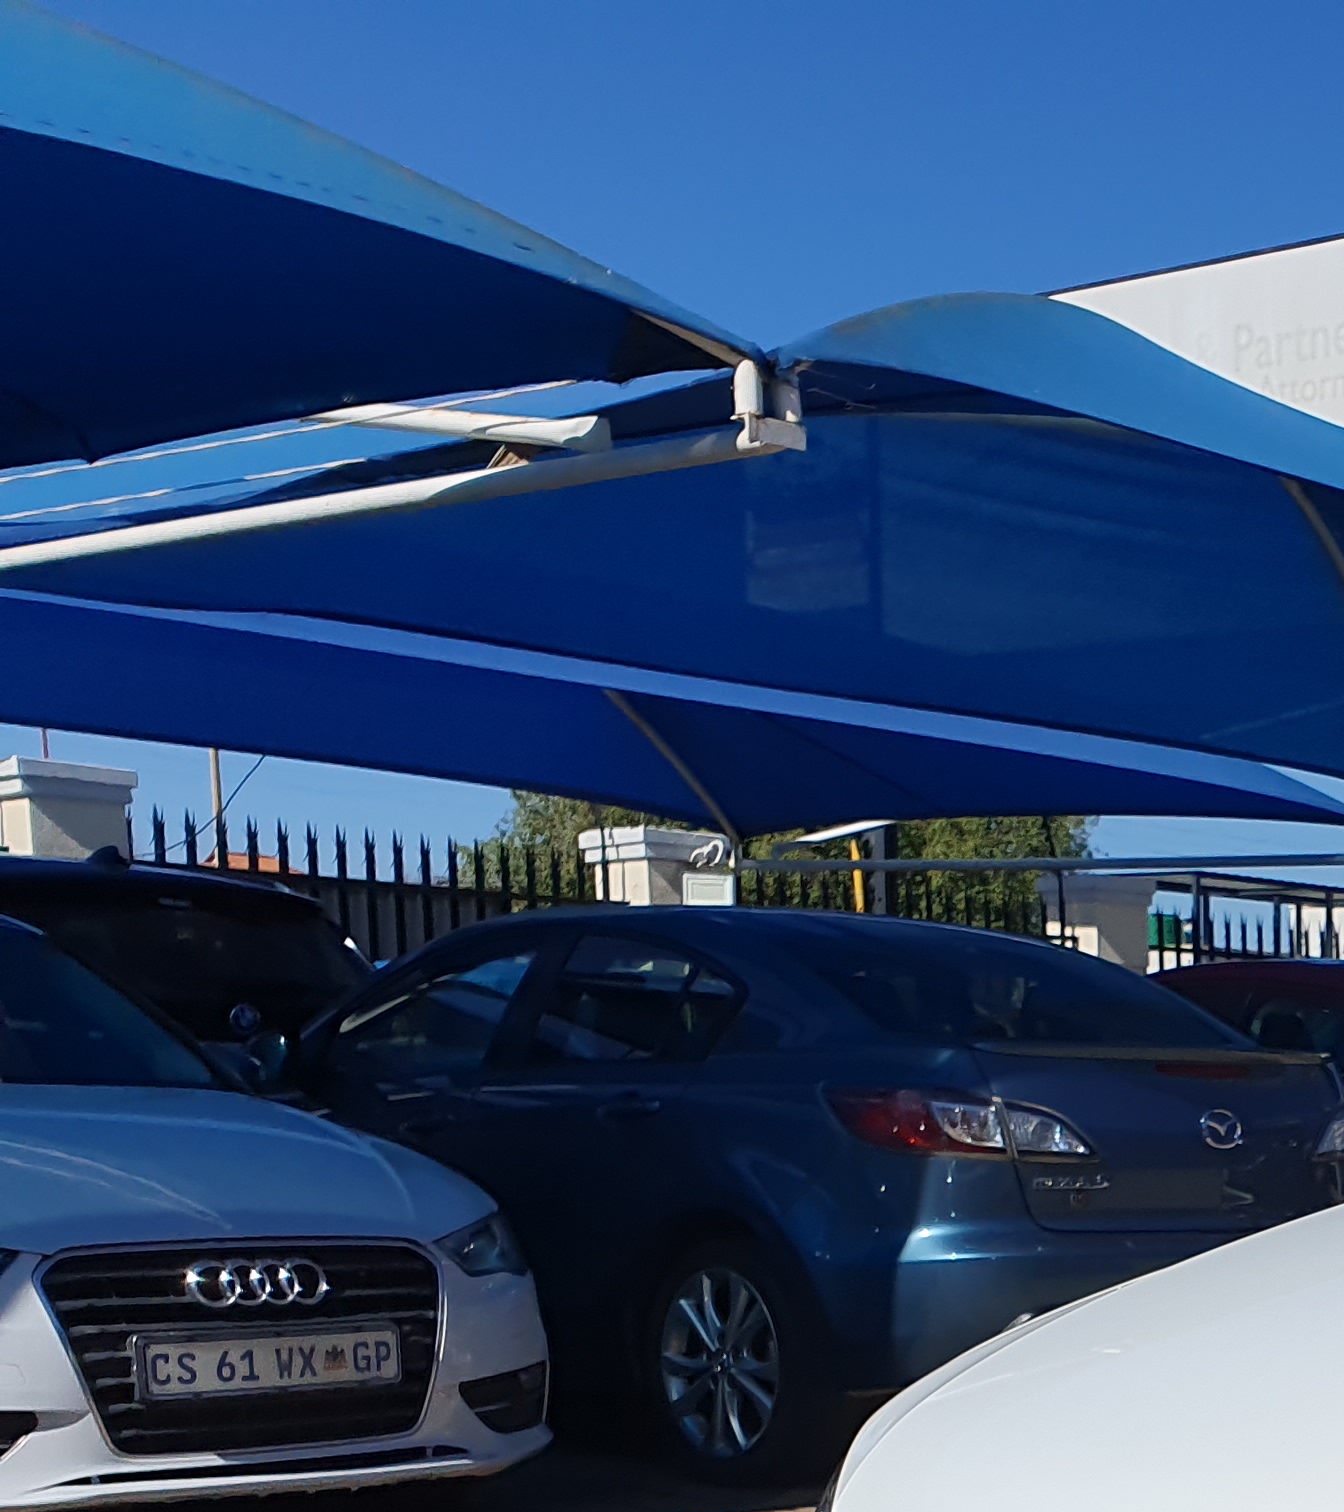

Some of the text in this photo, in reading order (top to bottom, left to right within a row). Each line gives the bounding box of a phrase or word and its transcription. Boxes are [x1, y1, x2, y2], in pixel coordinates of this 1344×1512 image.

[151, 1340, 391, 1386] CS 61 WX GP
